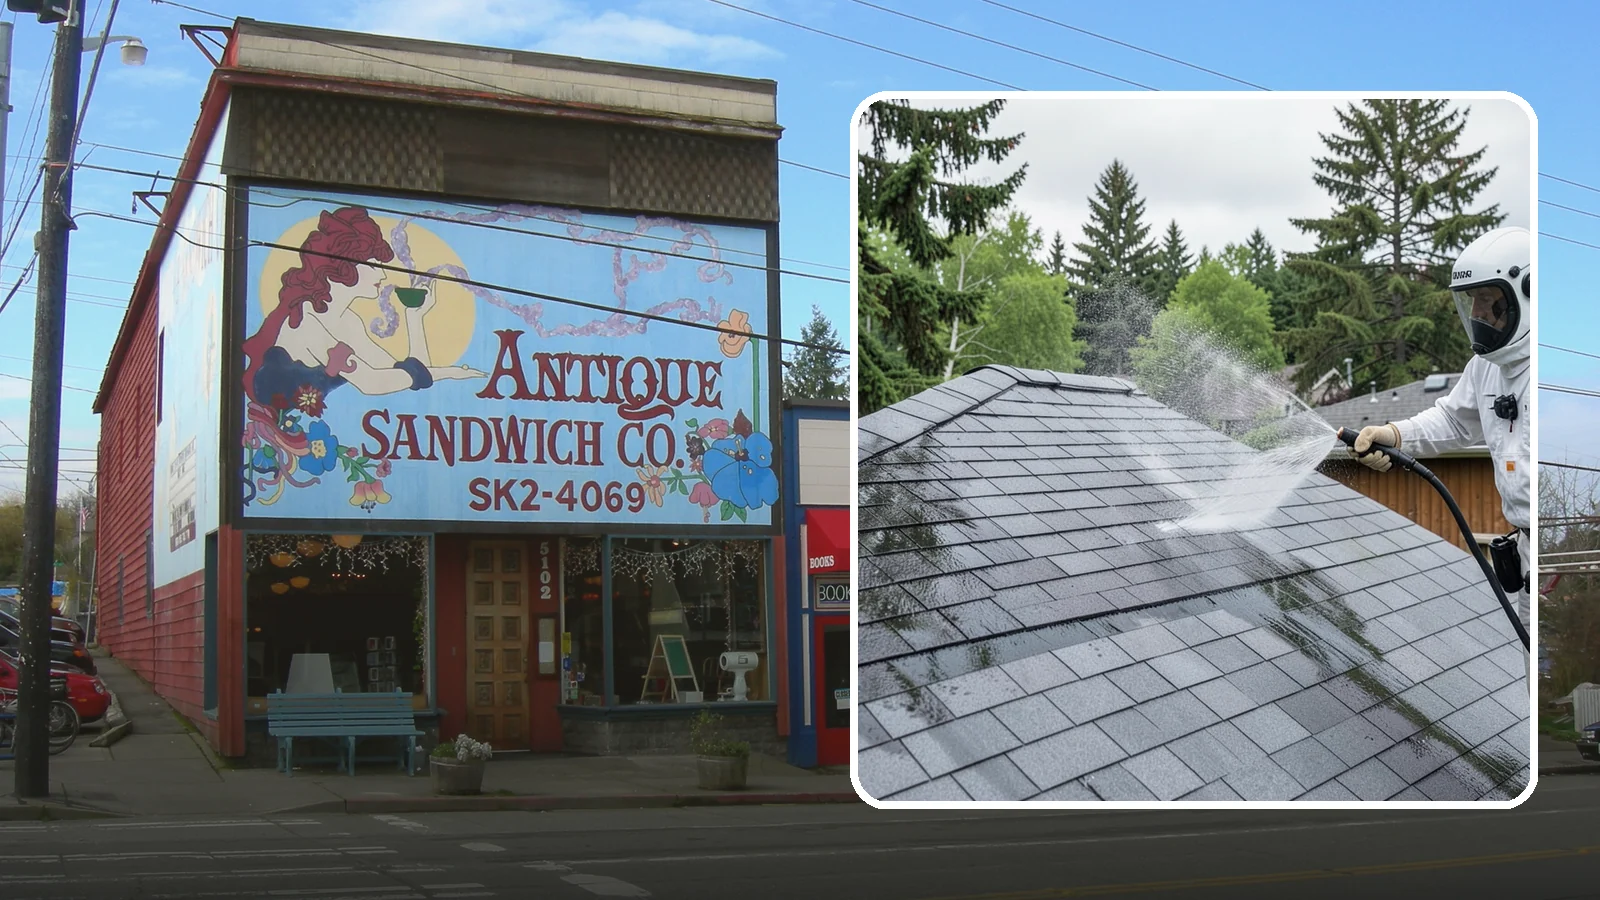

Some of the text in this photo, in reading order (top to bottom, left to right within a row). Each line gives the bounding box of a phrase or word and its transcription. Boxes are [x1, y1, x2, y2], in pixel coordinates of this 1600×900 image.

[475, 329, 724, 421] ANTIQUE
[361, 408, 685, 469] SANDWICH CO.
[468, 477, 646, 514] SK2-4069
[539, 540, 552, 600] 5102
[809, 555, 835, 569] BOOKS
